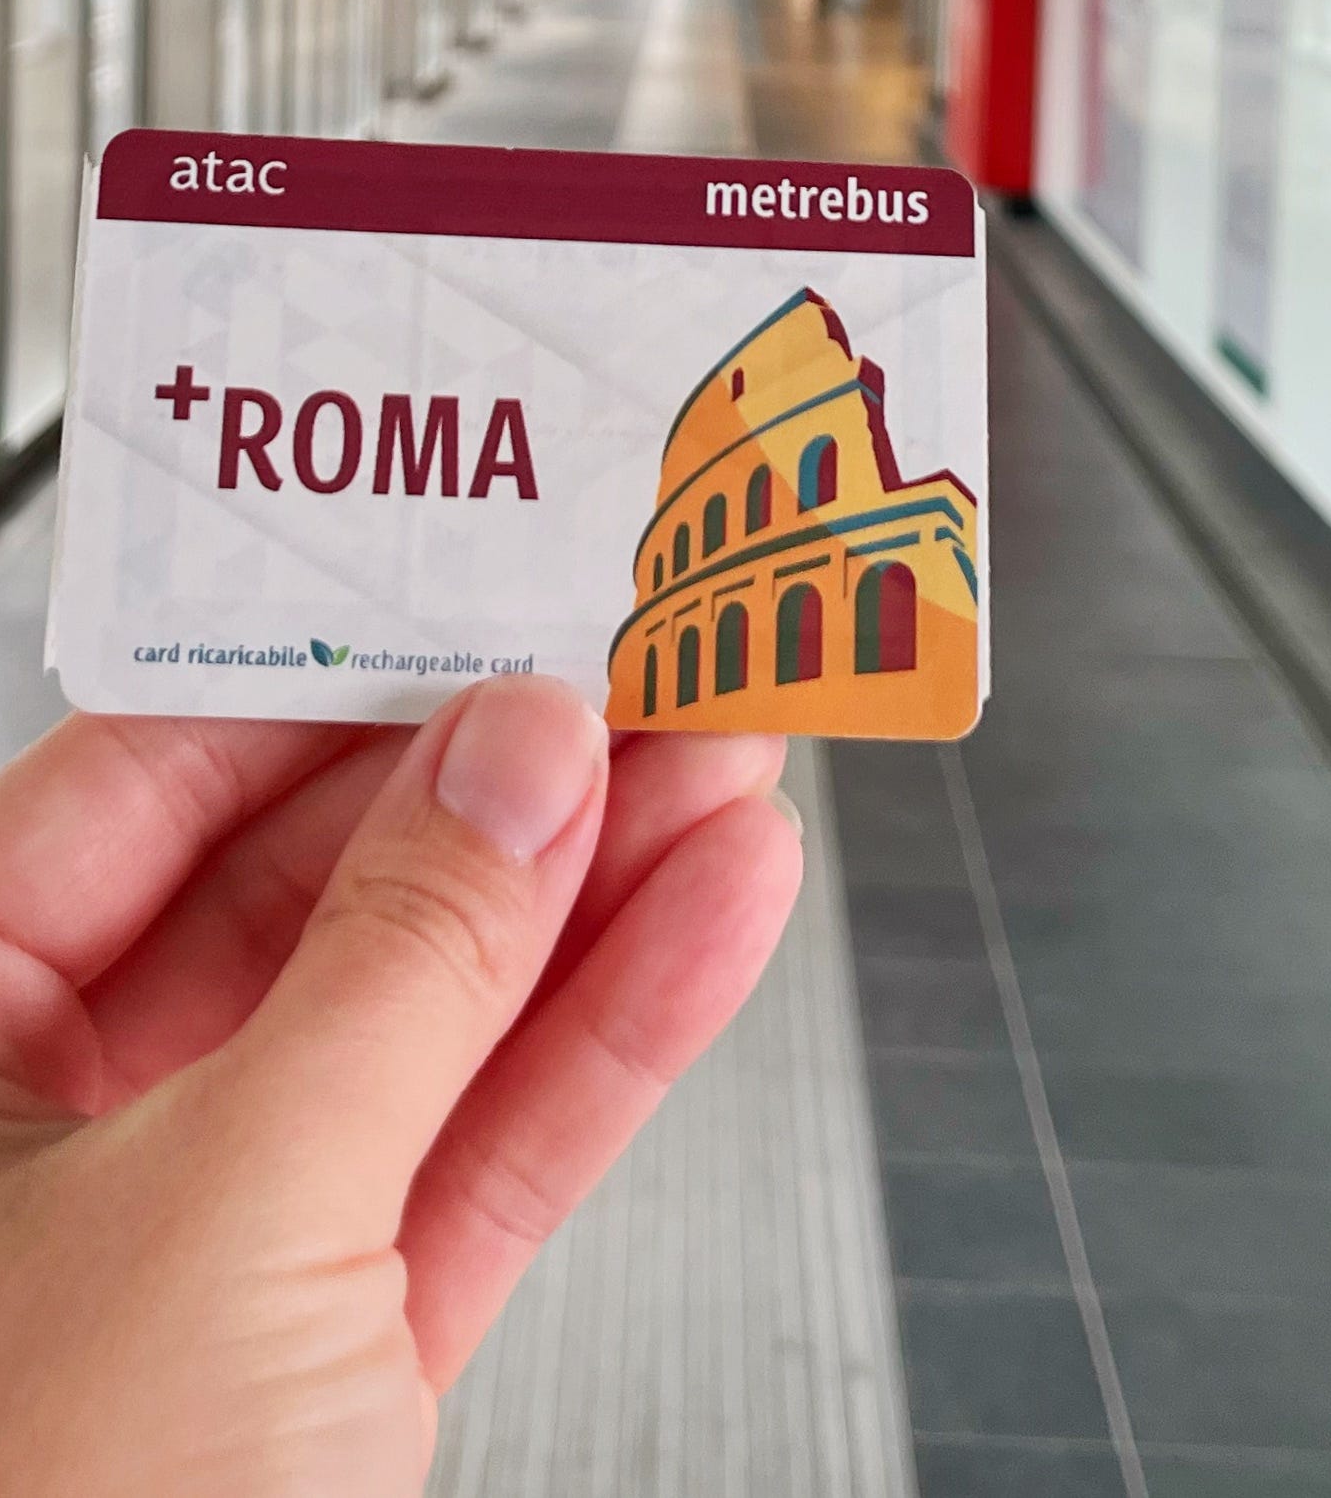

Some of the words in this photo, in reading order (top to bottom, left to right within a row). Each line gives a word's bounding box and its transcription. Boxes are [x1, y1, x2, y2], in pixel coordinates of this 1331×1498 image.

[169, 150, 288, 195] atac
[705, 176, 930, 225] metrebus
[133, 642, 181, 664] card
[187, 642, 308, 668] ricaricabile
[350, 649, 484, 676] rechargeable
[490, 653, 535, 674] card
